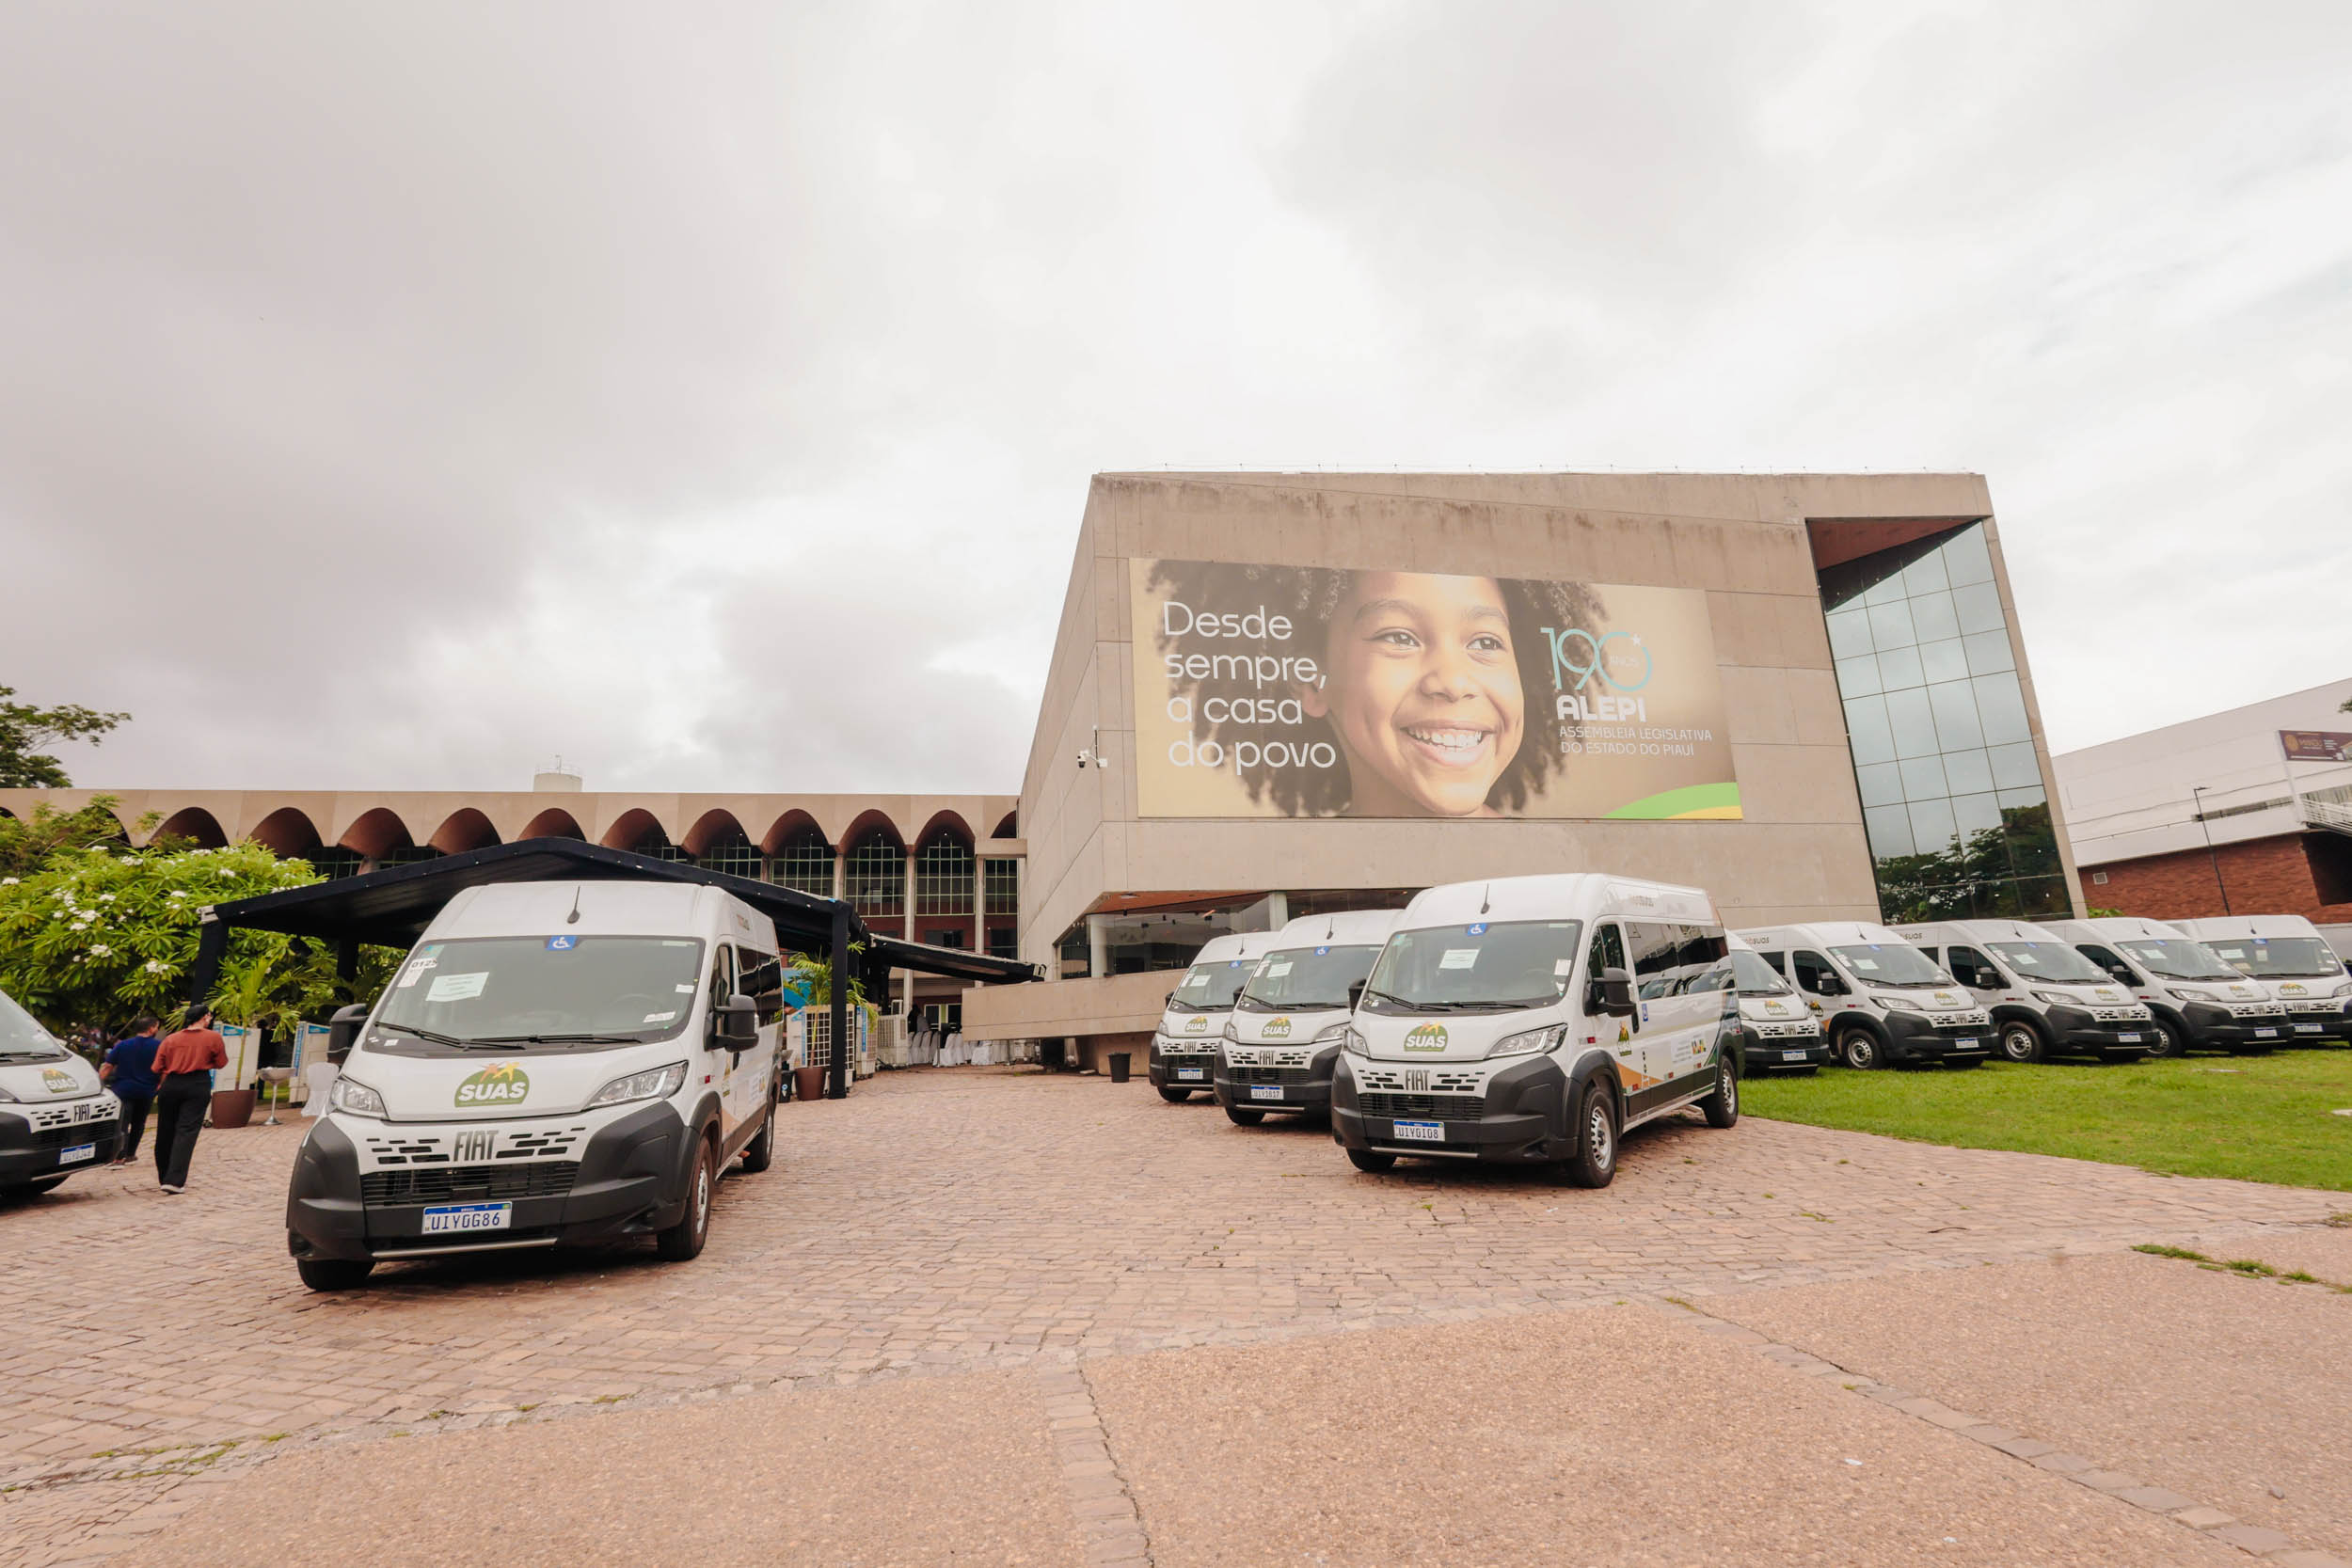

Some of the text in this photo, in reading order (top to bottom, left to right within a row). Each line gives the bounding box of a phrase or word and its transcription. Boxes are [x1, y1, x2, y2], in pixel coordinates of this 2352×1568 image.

[1164, 601, 1293, 641] Desde
[1540, 626, 1652, 692] 190
[1165, 654, 1327, 689] sempre,
[1167, 696, 1303, 724] a casa
[1556, 694, 1647, 722] ALEPI
[1559, 725, 1712, 741] ASSEMBLEIA LEGISLATIVA
[1168, 730, 1337, 776] do povo
[1560, 741, 1582, 753] DO
[1585, 742, 1636, 754] ESTADO
[1640, 743, 1660, 755] DO
[1263, 1025, 1290, 1035] SUAS
[1406, 1035, 1446, 1048] SUAS
[1259, 1050, 1276, 1066] FIAT
[45, 1077, 79, 1090] SUAS
[1405, 1069, 1430, 1091] FIAT
[457, 1081, 527, 1101] SUAS
[73, 1103, 91, 1123] FIAT
[453, 1130, 500, 1163] FIAT
